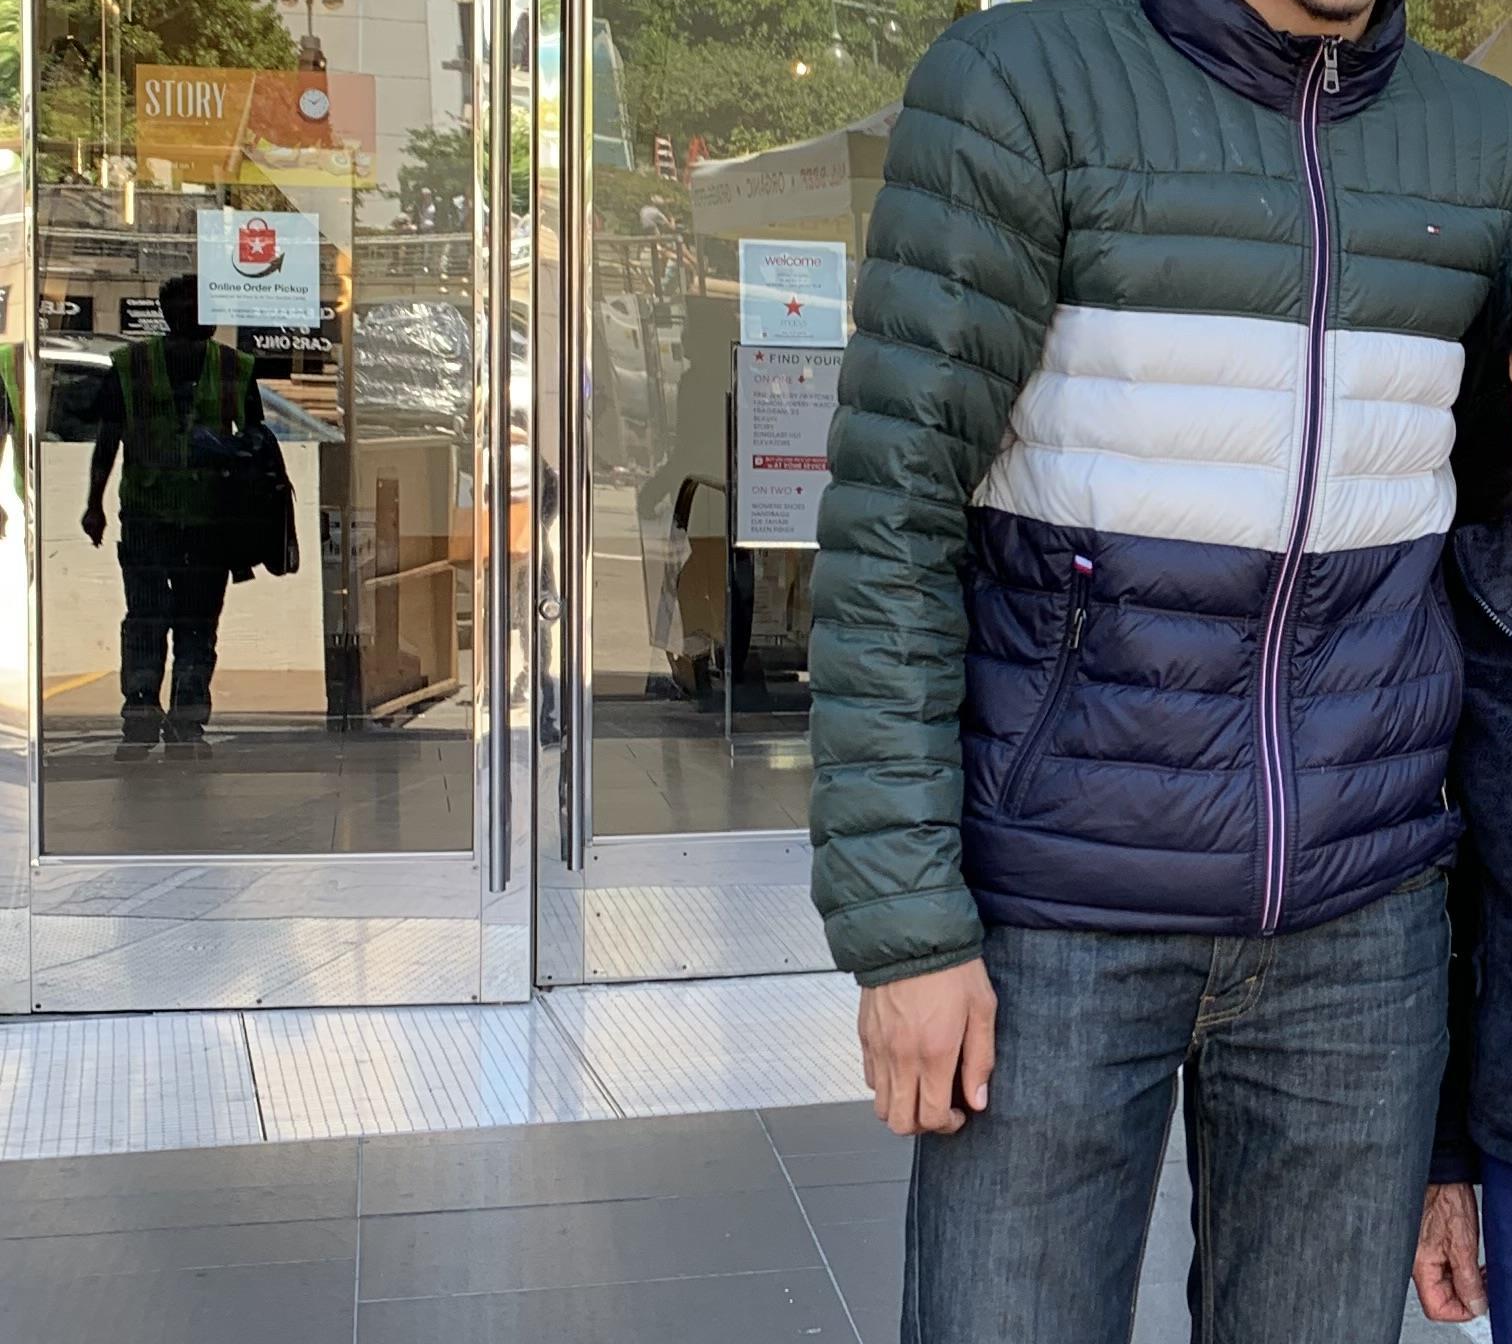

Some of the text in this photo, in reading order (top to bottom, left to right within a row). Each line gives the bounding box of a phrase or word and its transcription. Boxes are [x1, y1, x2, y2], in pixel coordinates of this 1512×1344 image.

[145, 79, 227, 119] STORY
[764, 253, 822, 267] welcome
[209, 281, 308, 295] Online Order Pickup
[769, 353, 842, 366] FIND YOUR
[752, 485, 793, 496] ON TWO
